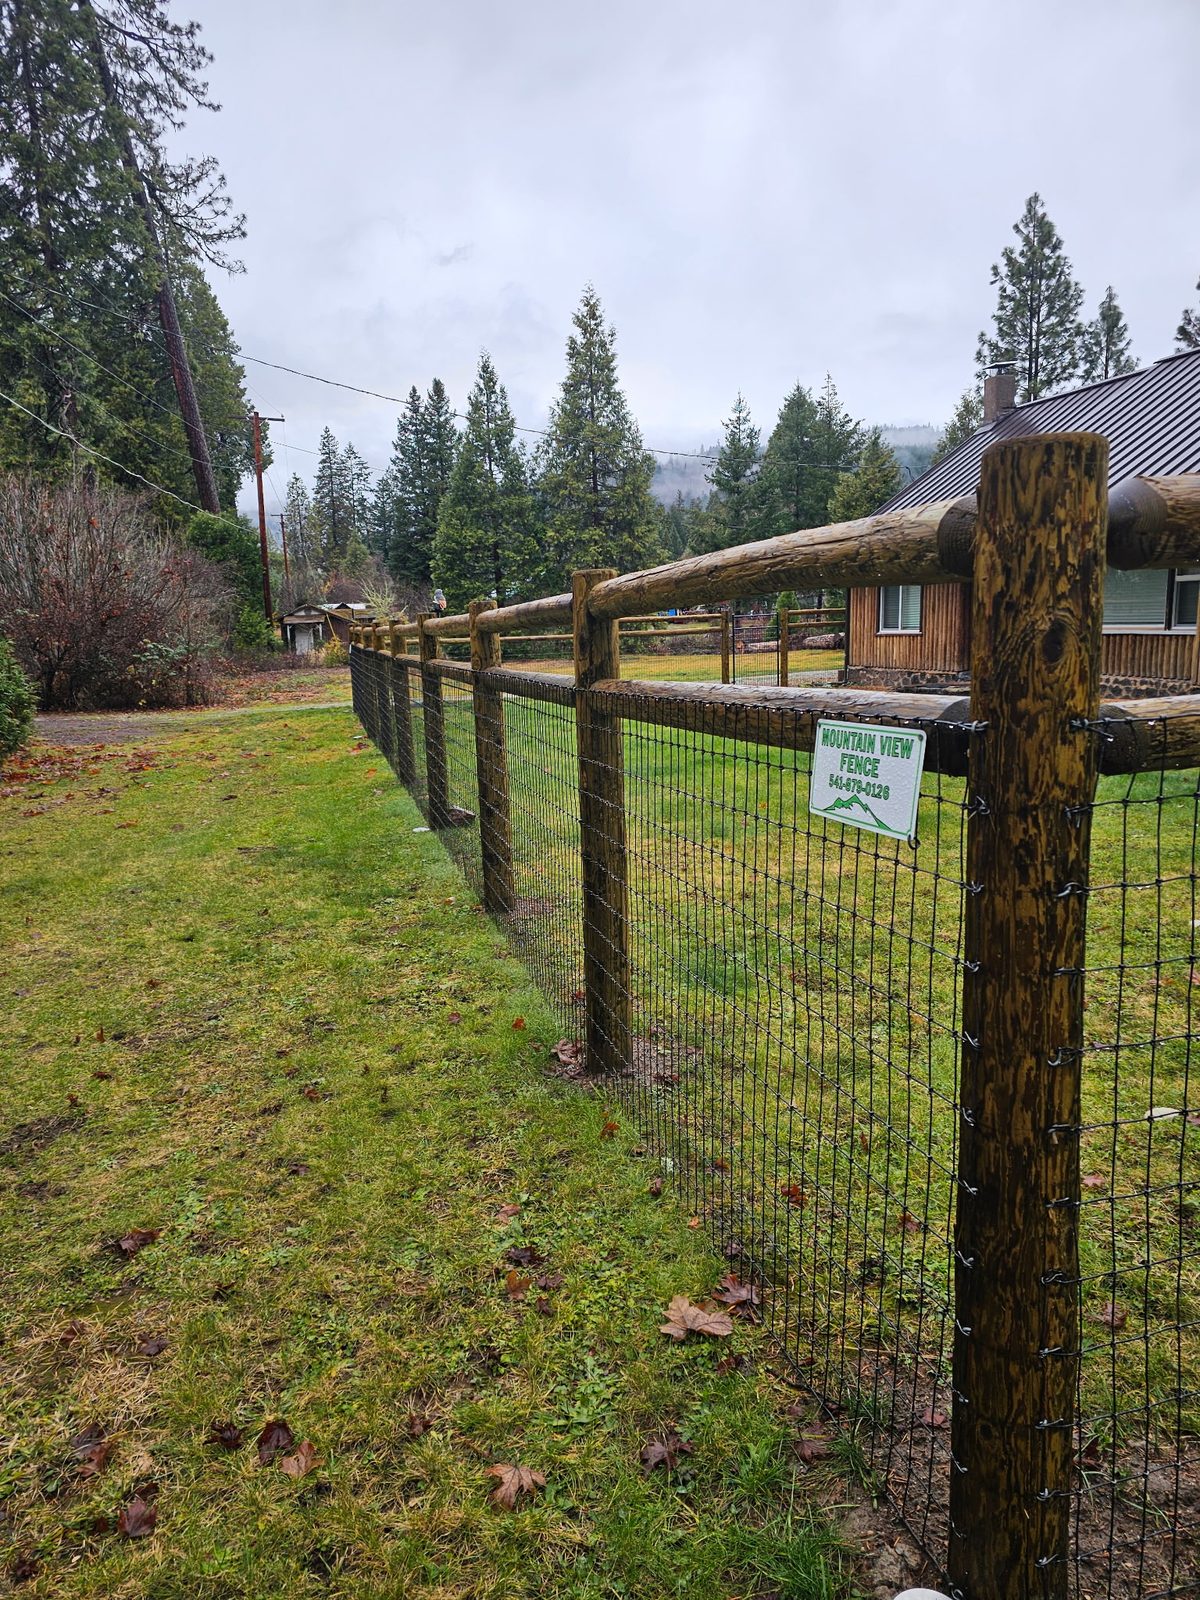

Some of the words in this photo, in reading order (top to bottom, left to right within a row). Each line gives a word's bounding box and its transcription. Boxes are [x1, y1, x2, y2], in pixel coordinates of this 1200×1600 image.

[821, 728, 876, 754] MOUNTAIN
[880, 735, 914, 759] VIEW
[840, 753, 880, 778] FENCE
